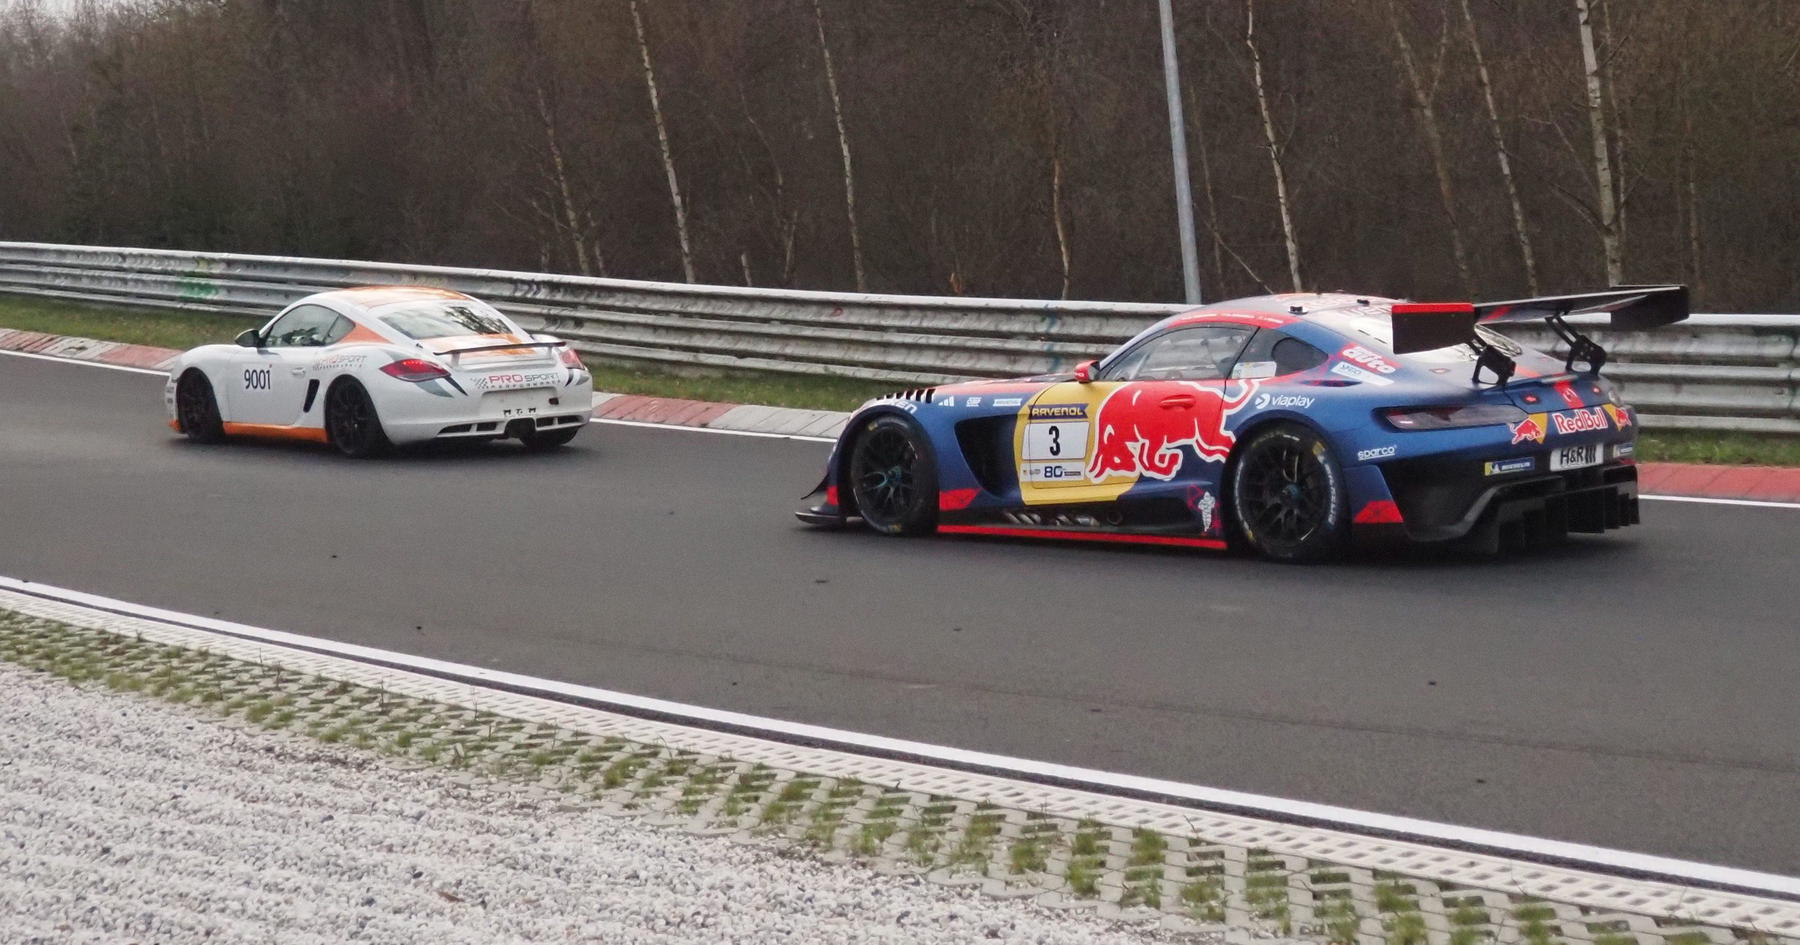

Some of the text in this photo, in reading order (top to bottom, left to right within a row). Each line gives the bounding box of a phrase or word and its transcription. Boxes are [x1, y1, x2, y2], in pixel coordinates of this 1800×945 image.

[244, 369, 271, 390] 9001
[1271, 394, 1315, 409] viaplay
[1031, 407, 1083, 416] RAVENOL
[1048, 425, 1061, 456] 3
[1357, 446, 1395, 460] sparco
